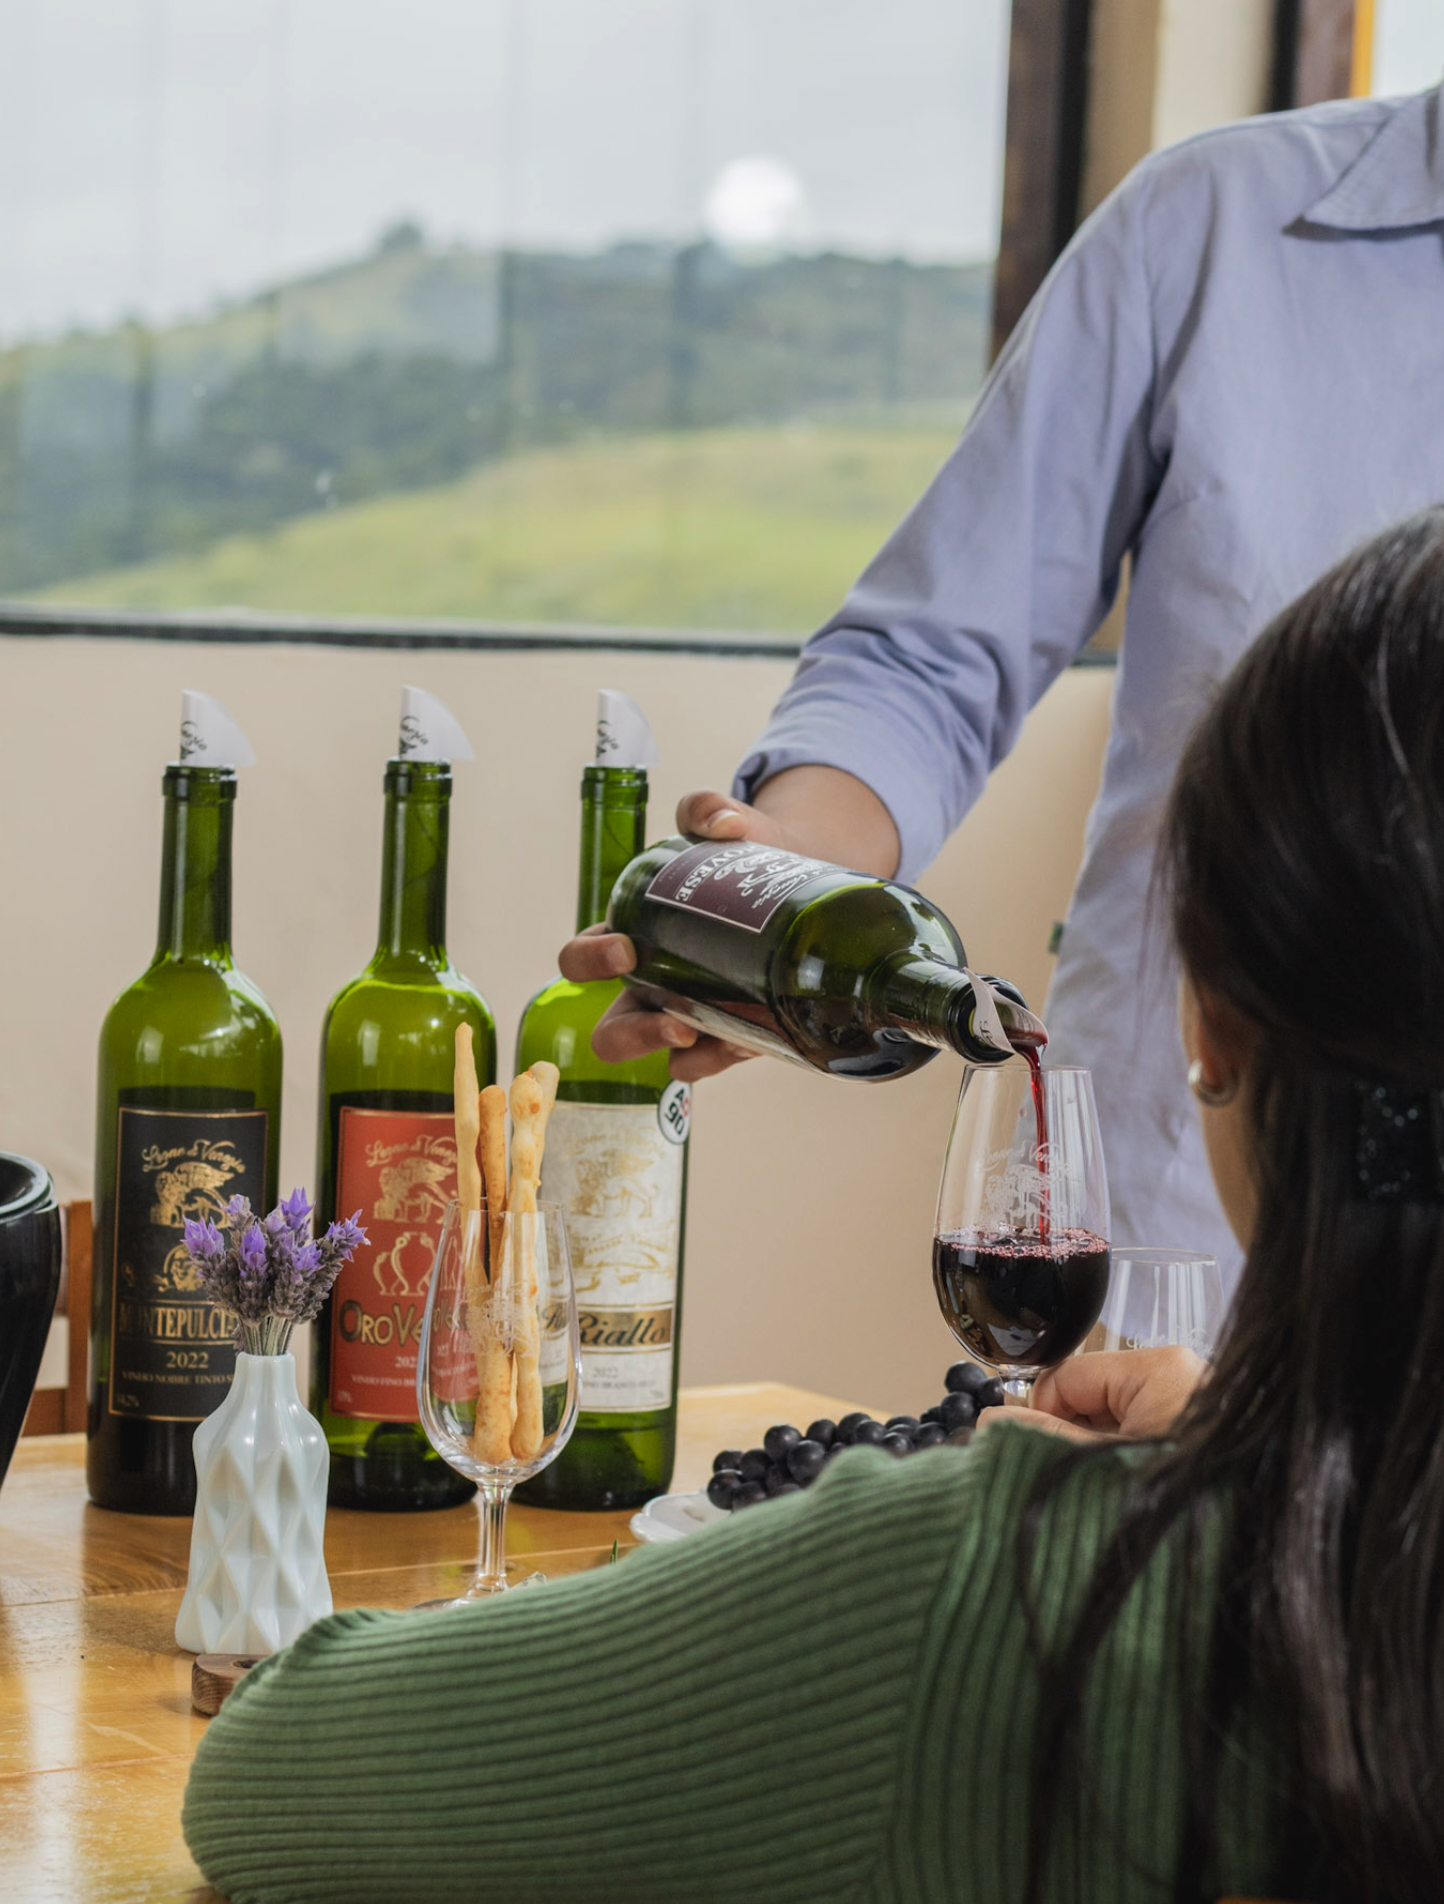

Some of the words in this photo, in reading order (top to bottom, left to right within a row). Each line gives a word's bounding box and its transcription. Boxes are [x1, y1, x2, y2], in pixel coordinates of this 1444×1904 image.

[578, 1311, 667, 1346] Riallo
[165, 1350, 210, 1370] 2022
[395, 1355, 418, 1369] 202
[194, 1374, 226, 1386] TINTO
